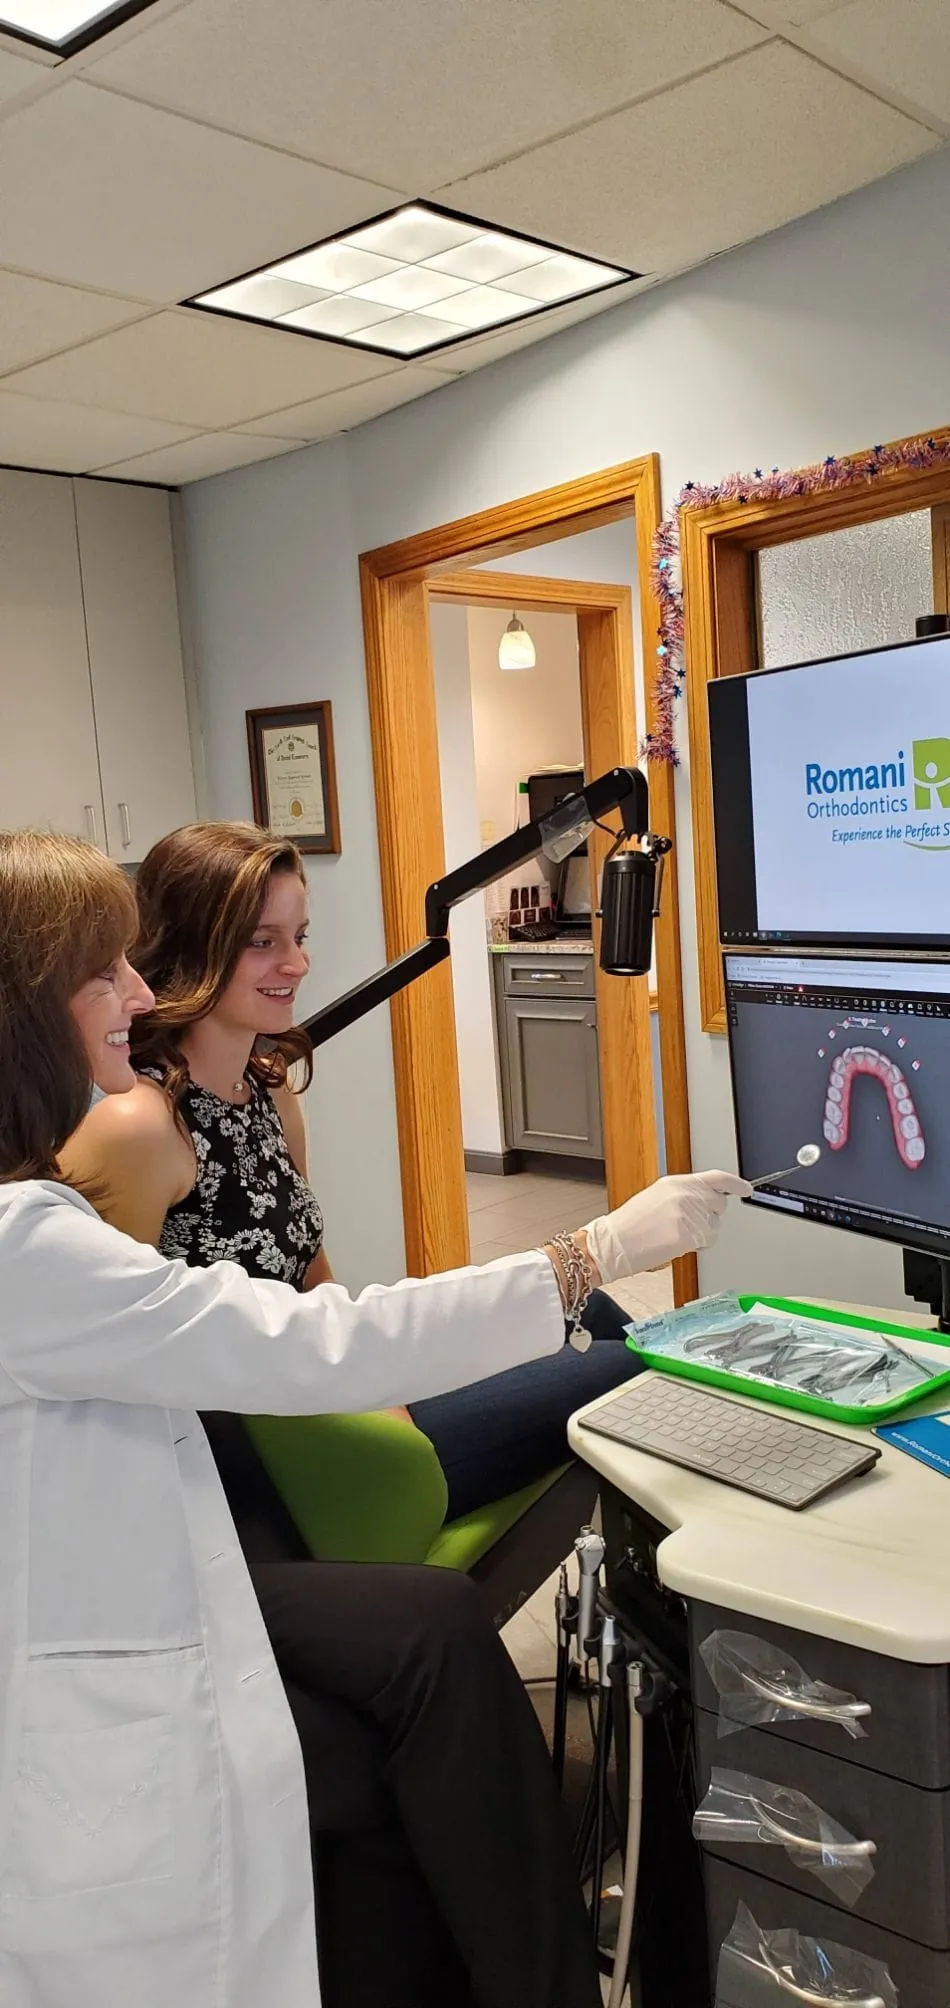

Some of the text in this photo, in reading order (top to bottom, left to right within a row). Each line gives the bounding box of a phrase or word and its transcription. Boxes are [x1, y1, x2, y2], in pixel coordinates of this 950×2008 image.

[805, 750, 905, 795] Romani
[807, 795, 908, 819] Orthodontics
[832, 827, 882, 844] Experience
[886, 824, 902, 839] the
[905, 822, 940, 842] Perfect
